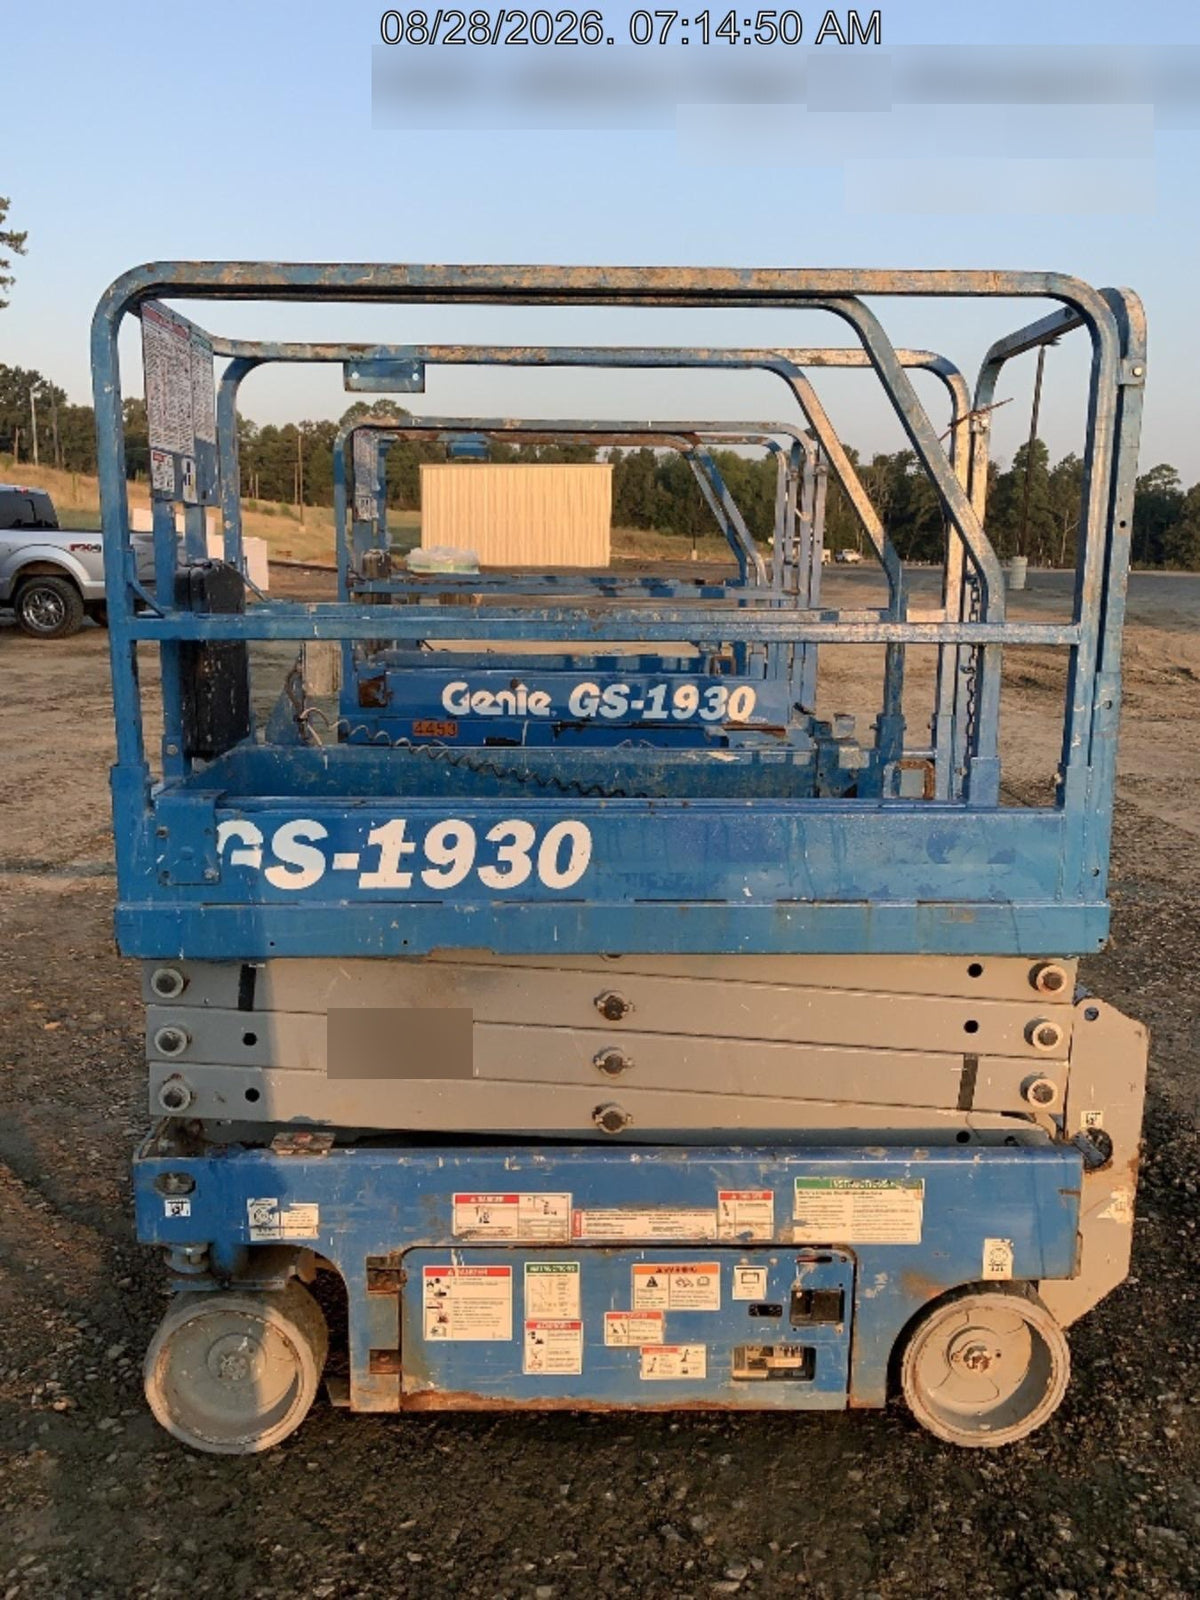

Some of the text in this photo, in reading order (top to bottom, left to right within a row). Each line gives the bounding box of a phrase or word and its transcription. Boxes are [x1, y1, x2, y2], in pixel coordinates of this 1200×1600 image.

[441, 682, 757, 722] Genie GS-1930
[413, 721, 457, 737] 4453
